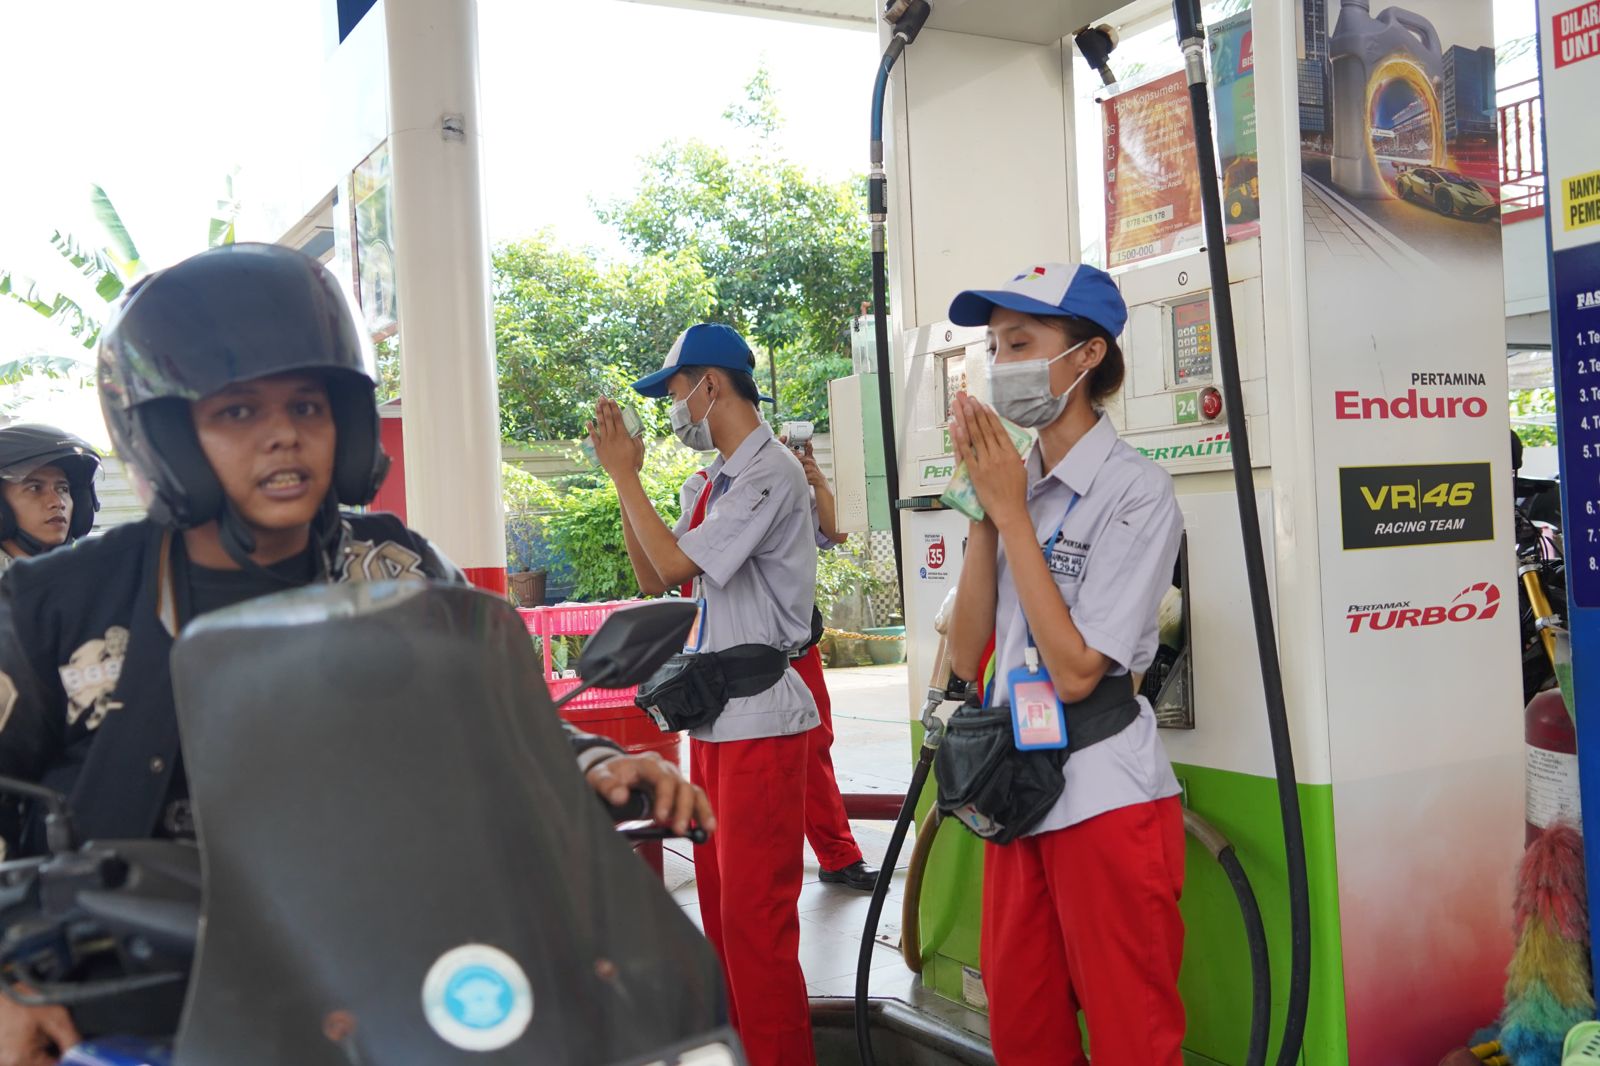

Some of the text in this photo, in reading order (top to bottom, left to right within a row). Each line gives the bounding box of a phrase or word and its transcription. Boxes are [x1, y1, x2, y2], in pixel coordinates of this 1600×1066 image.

[1561, 3, 1600, 37] DILAR
[1561, 29, 1600, 62] UNT
[1132, 81, 1183, 106] Konsumen:
[1576, 290, 1600, 308] FAS
[1576, 332, 1586, 346] 1.
[1578, 360, 1588, 375] 2.
[1411, 372, 1486, 386] PERTAMINA
[1579, 388, 1589, 402] 3.
[1178, 400, 1196, 416] 24
[1334, 389, 1488, 420] Enduro
[1581, 415, 1600, 430] 4. T
[944, 434, 951, 447] 2
[1583, 444, 1592, 458] 5.
[923, 465, 956, 479] PER
[1586, 500, 1596, 515] 6.
[1374, 518, 1465, 535] RACING TEAM
[1587, 528, 1597, 543] 7.
[1589, 556, 1599, 571] 8.
[1348, 601, 1411, 613] PERTAMAX
[1346, 603, 1478, 633] TURBO
